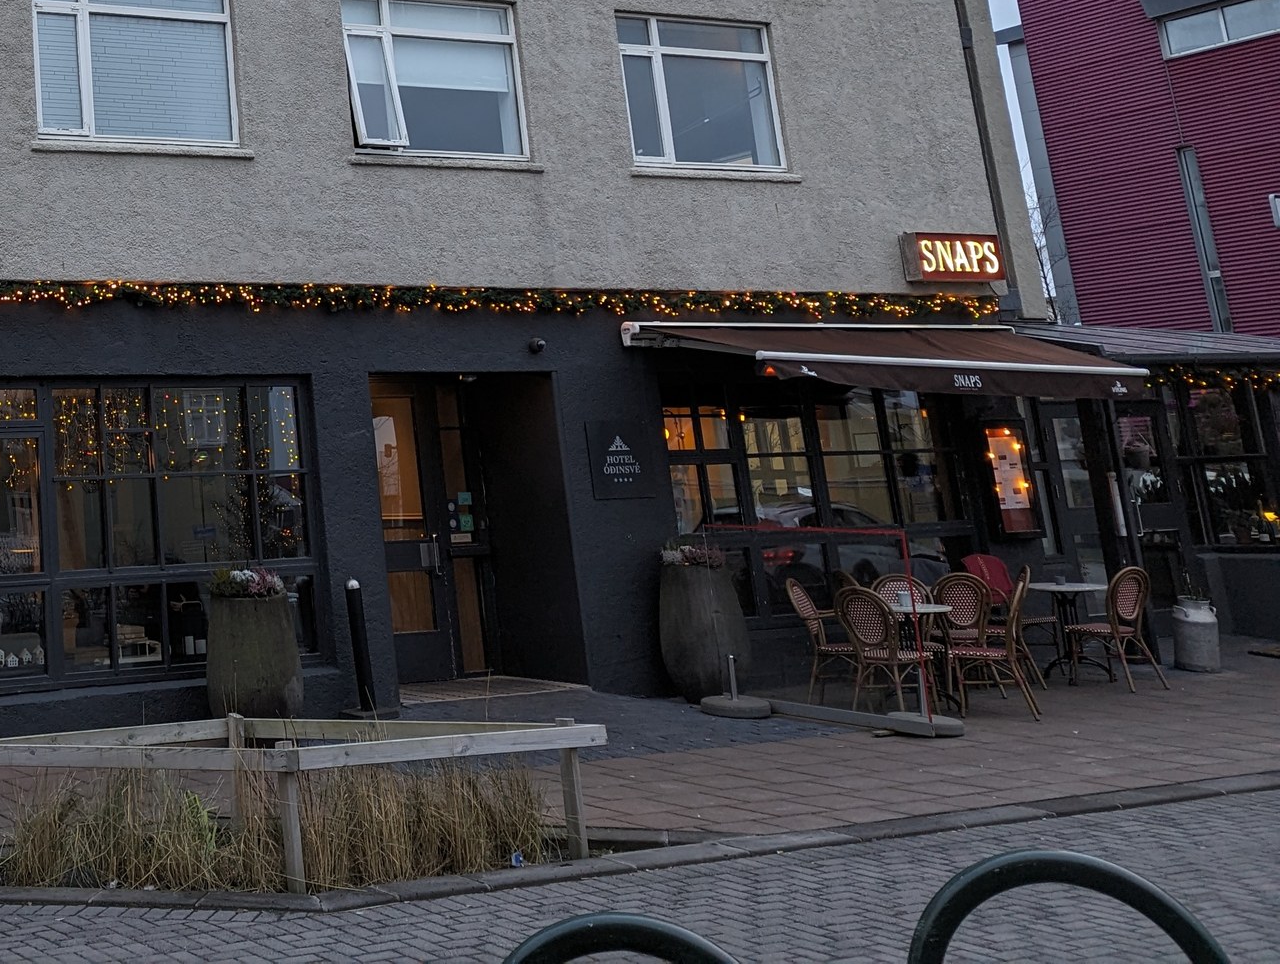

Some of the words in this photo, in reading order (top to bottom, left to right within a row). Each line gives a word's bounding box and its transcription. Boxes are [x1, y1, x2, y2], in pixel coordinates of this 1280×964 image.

[920, 239, 1000, 274] SNAPS
[953, 374, 982, 388] SNAPS
[606, 455, 636, 464] HOTEL
